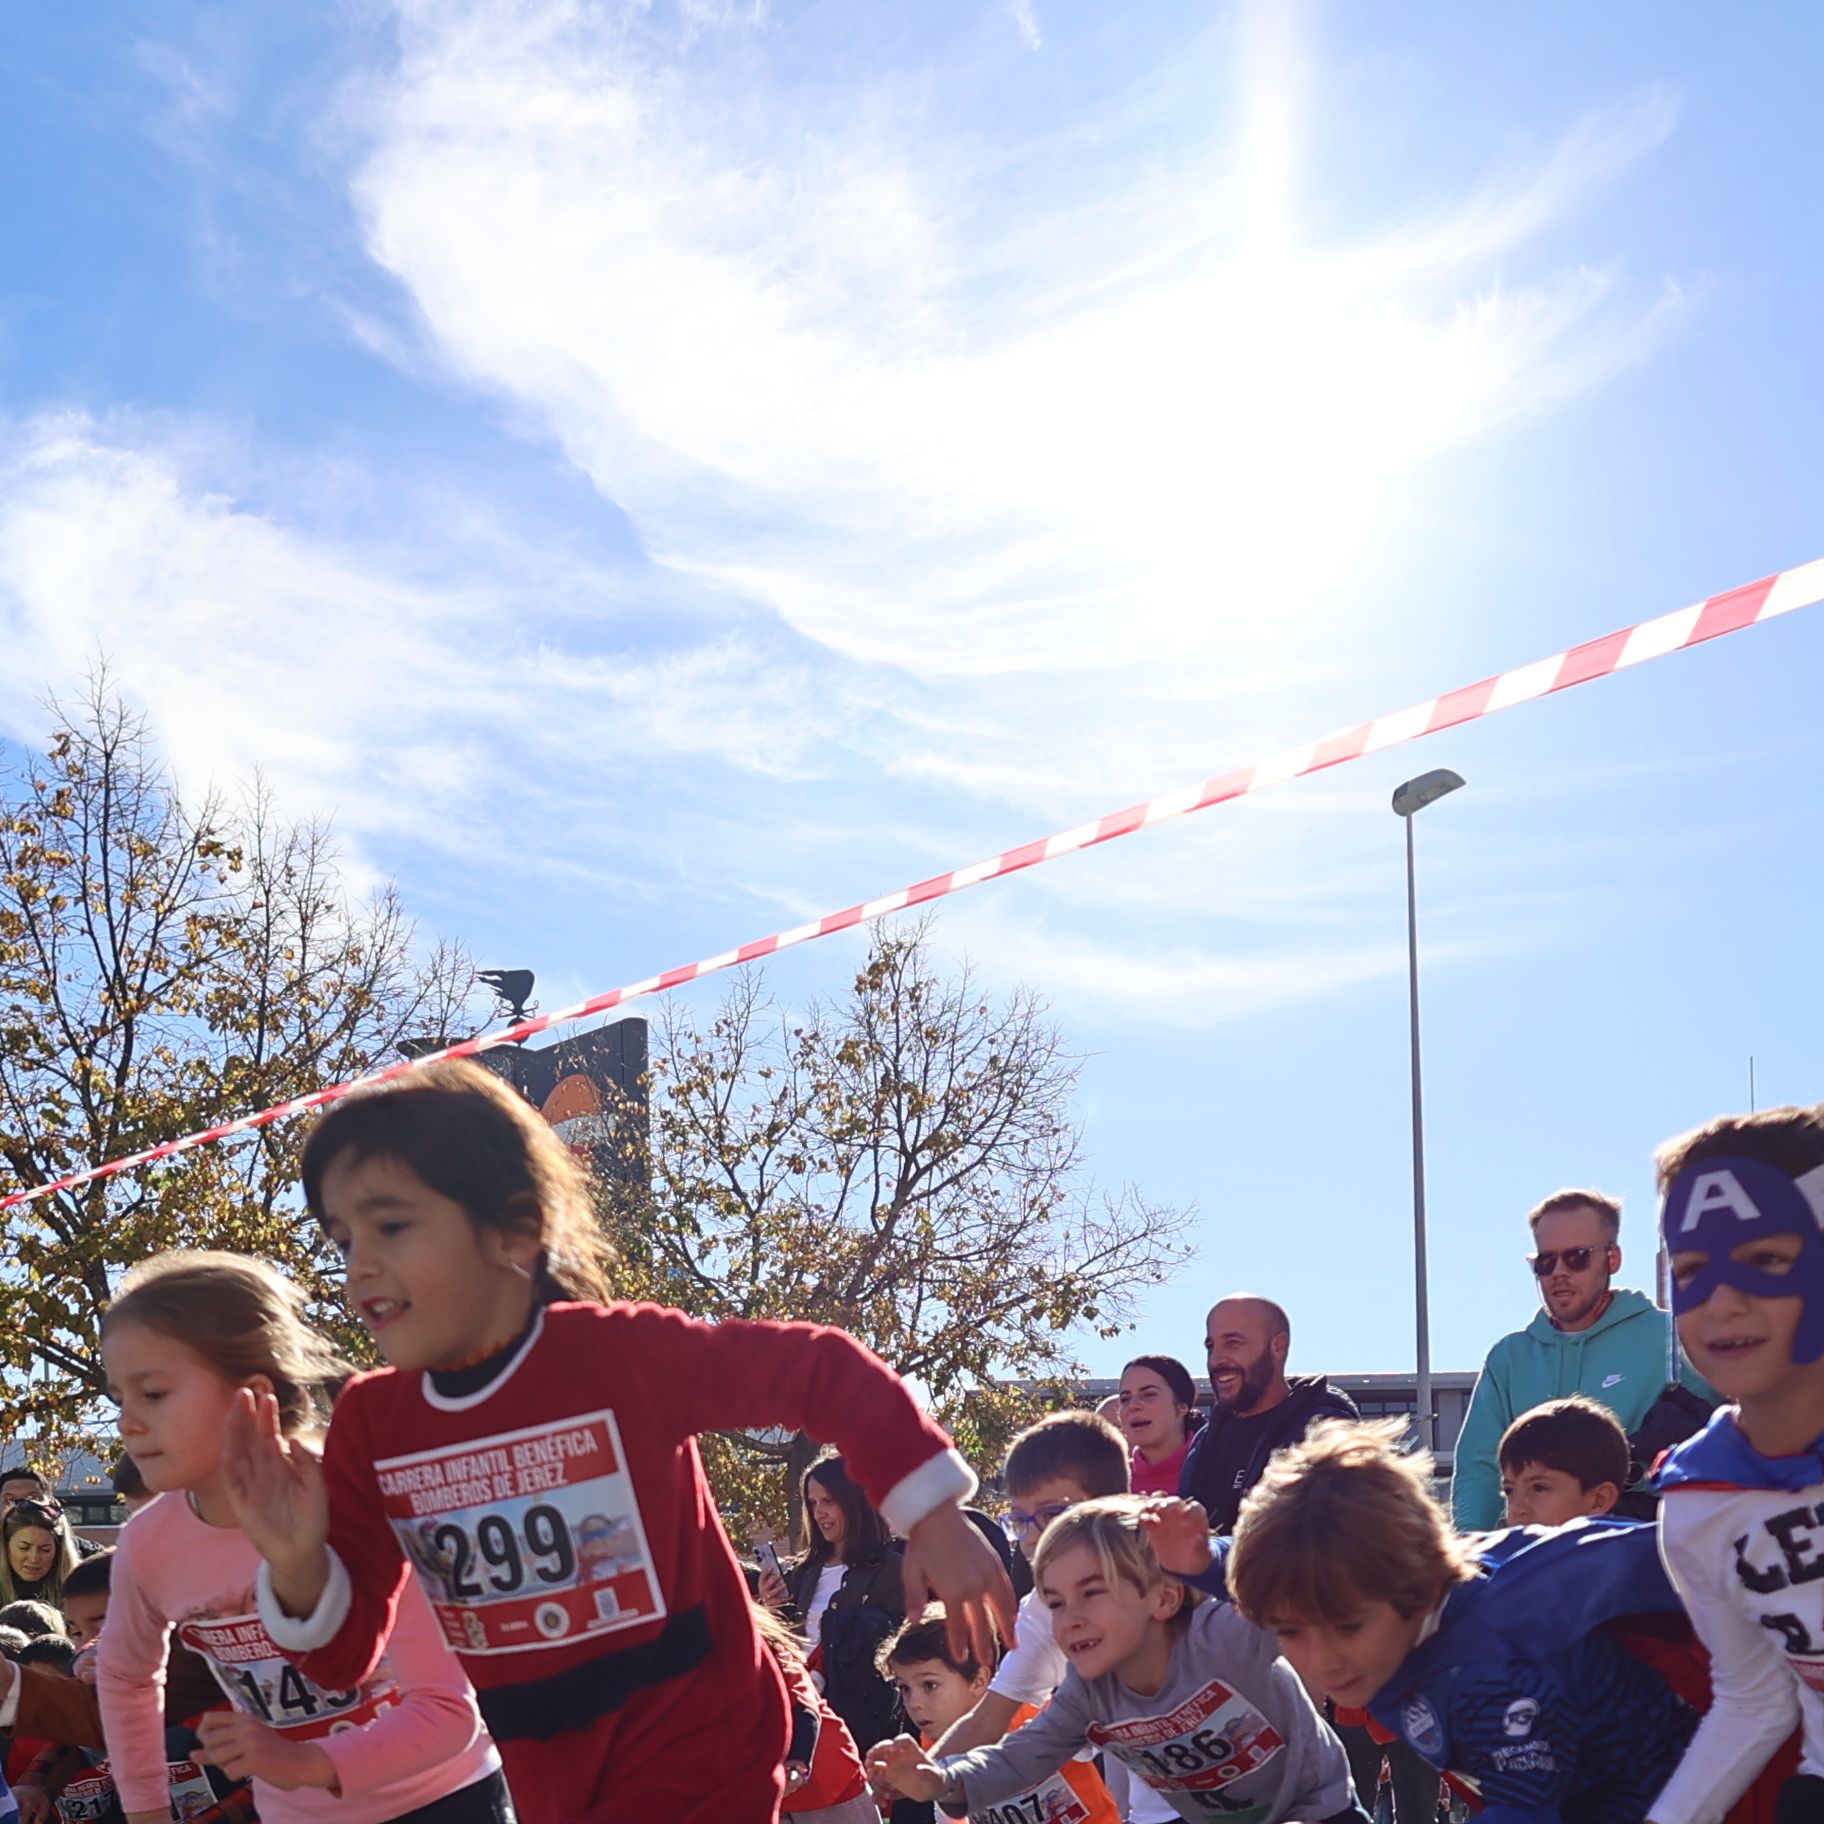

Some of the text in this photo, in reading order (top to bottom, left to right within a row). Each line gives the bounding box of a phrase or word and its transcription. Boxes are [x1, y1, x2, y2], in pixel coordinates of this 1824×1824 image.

[1681, 1168, 1762, 1233] A
[378, 1428, 598, 1497] CARRERA INFANTIL BENÉFICA
[409, 1462, 568, 1515] BOMBEROS DE JEREZ
[435, 1504, 575, 1597] 299
[236, 1664, 359, 1722] 14
[1142, 1729, 1232, 1775] 186
